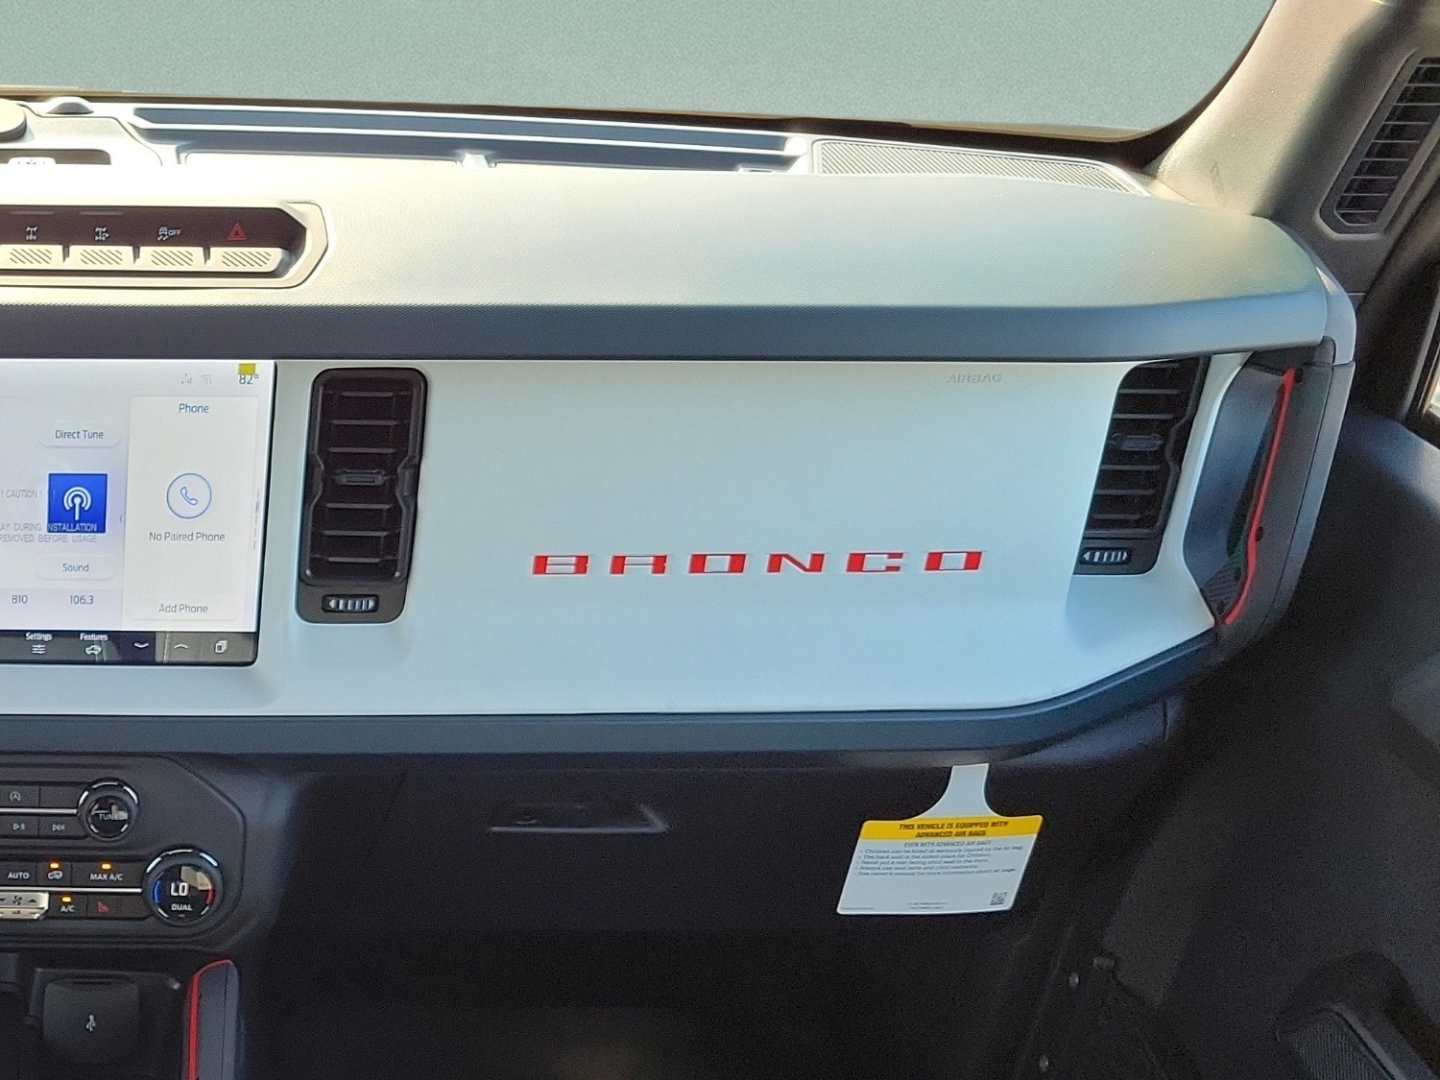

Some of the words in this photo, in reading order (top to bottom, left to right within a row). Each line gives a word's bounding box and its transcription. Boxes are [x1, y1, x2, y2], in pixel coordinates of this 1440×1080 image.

[178, 403, 209, 413] Phone
[55, 429, 80, 440] Direct
[82, 429, 104, 440] Tune
[149, 532, 162, 541] No
[164, 532, 194, 541] Paired
[196, 532, 225, 542] Phone
[62, 563, 89, 572] Sound
[531, 550, 983, 576] BRONCO
[11, 594, 28, 604] 810
[70, 594, 94, 605] 106.3
[159, 603, 177, 613] Add
[179, 604, 208, 614] Phone
[25, 632, 53, 641] Settings
[8, 871, 30, 879] AUTO
[90, 873, 108, 881] MAX
[109, 873, 124, 881] A/C
[60, 904, 75, 913] A/C
[171, 903, 192, 912] DUAL
